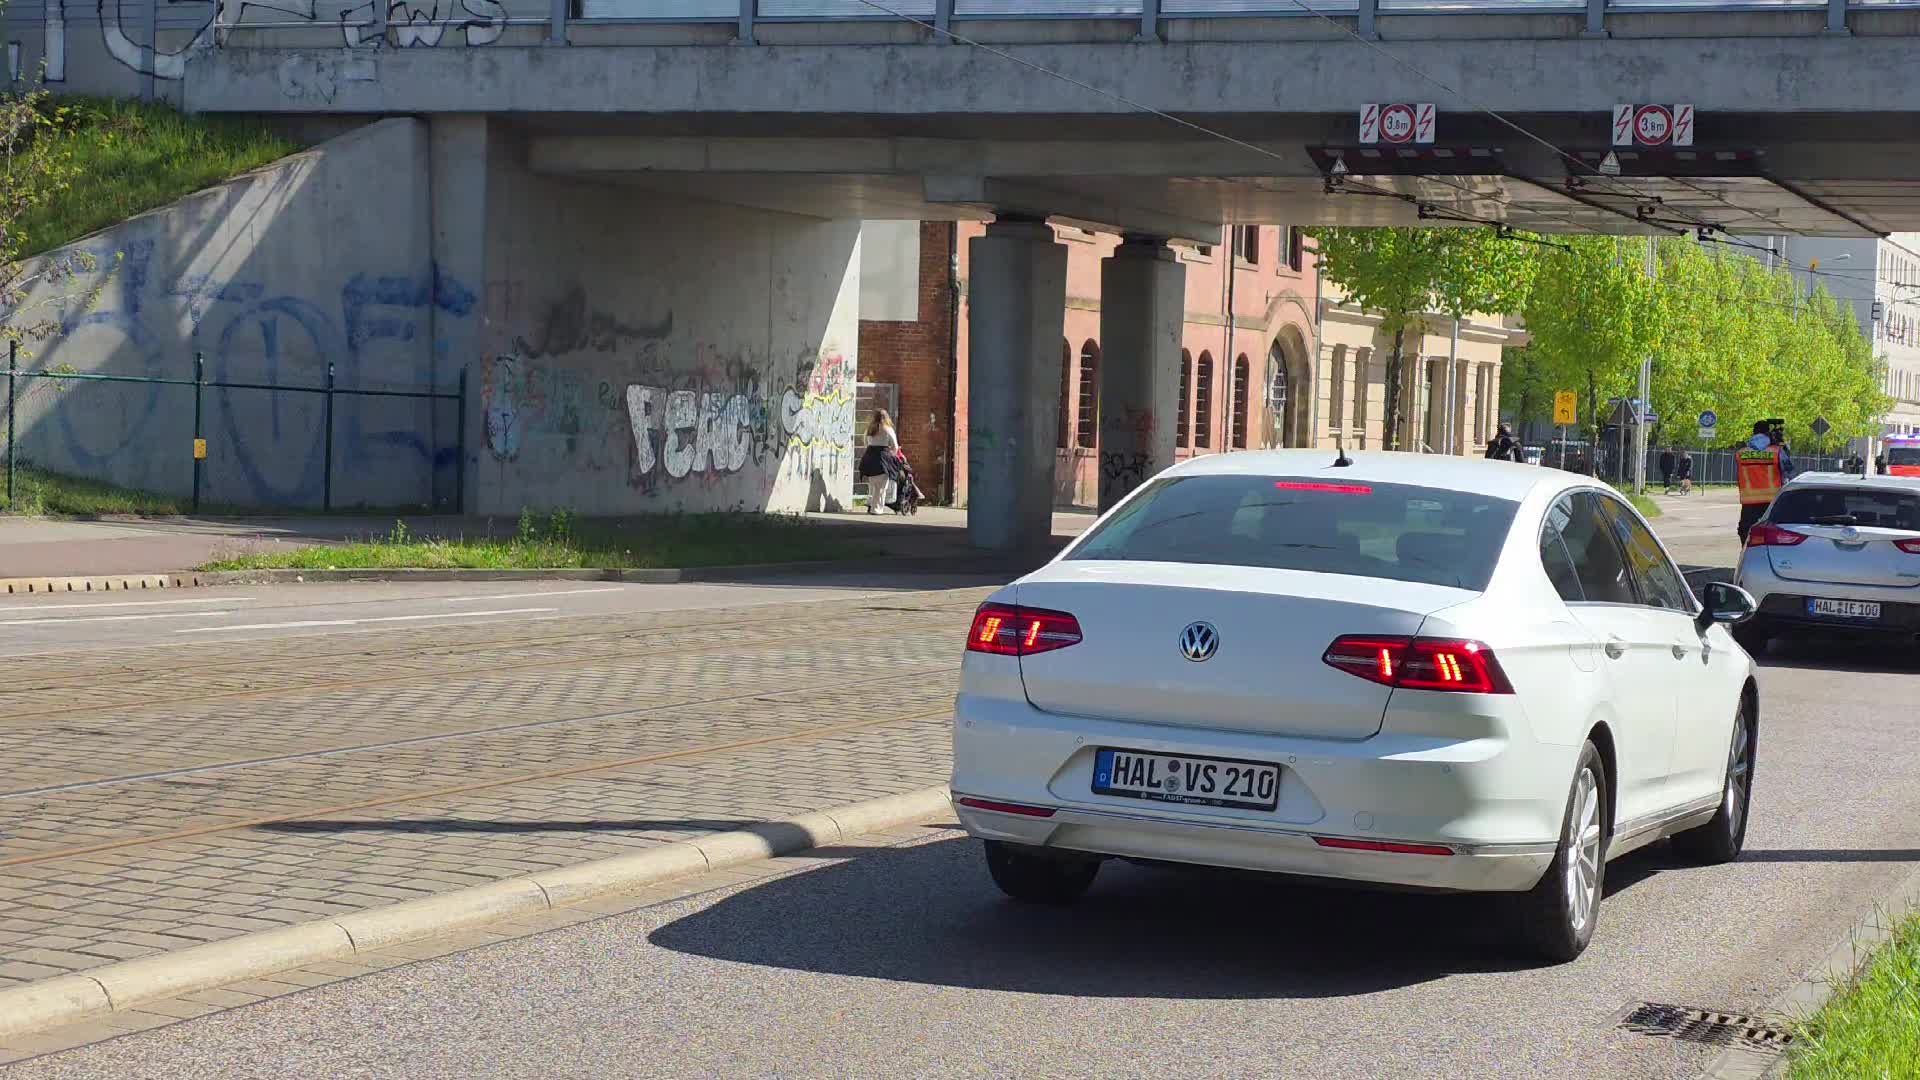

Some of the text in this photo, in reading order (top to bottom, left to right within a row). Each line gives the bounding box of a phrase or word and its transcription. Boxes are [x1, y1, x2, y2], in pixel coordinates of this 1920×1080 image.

[1815, 600, 1878, 616] HAL IE 100
[1112, 755, 1274, 800] HAL VS 210
